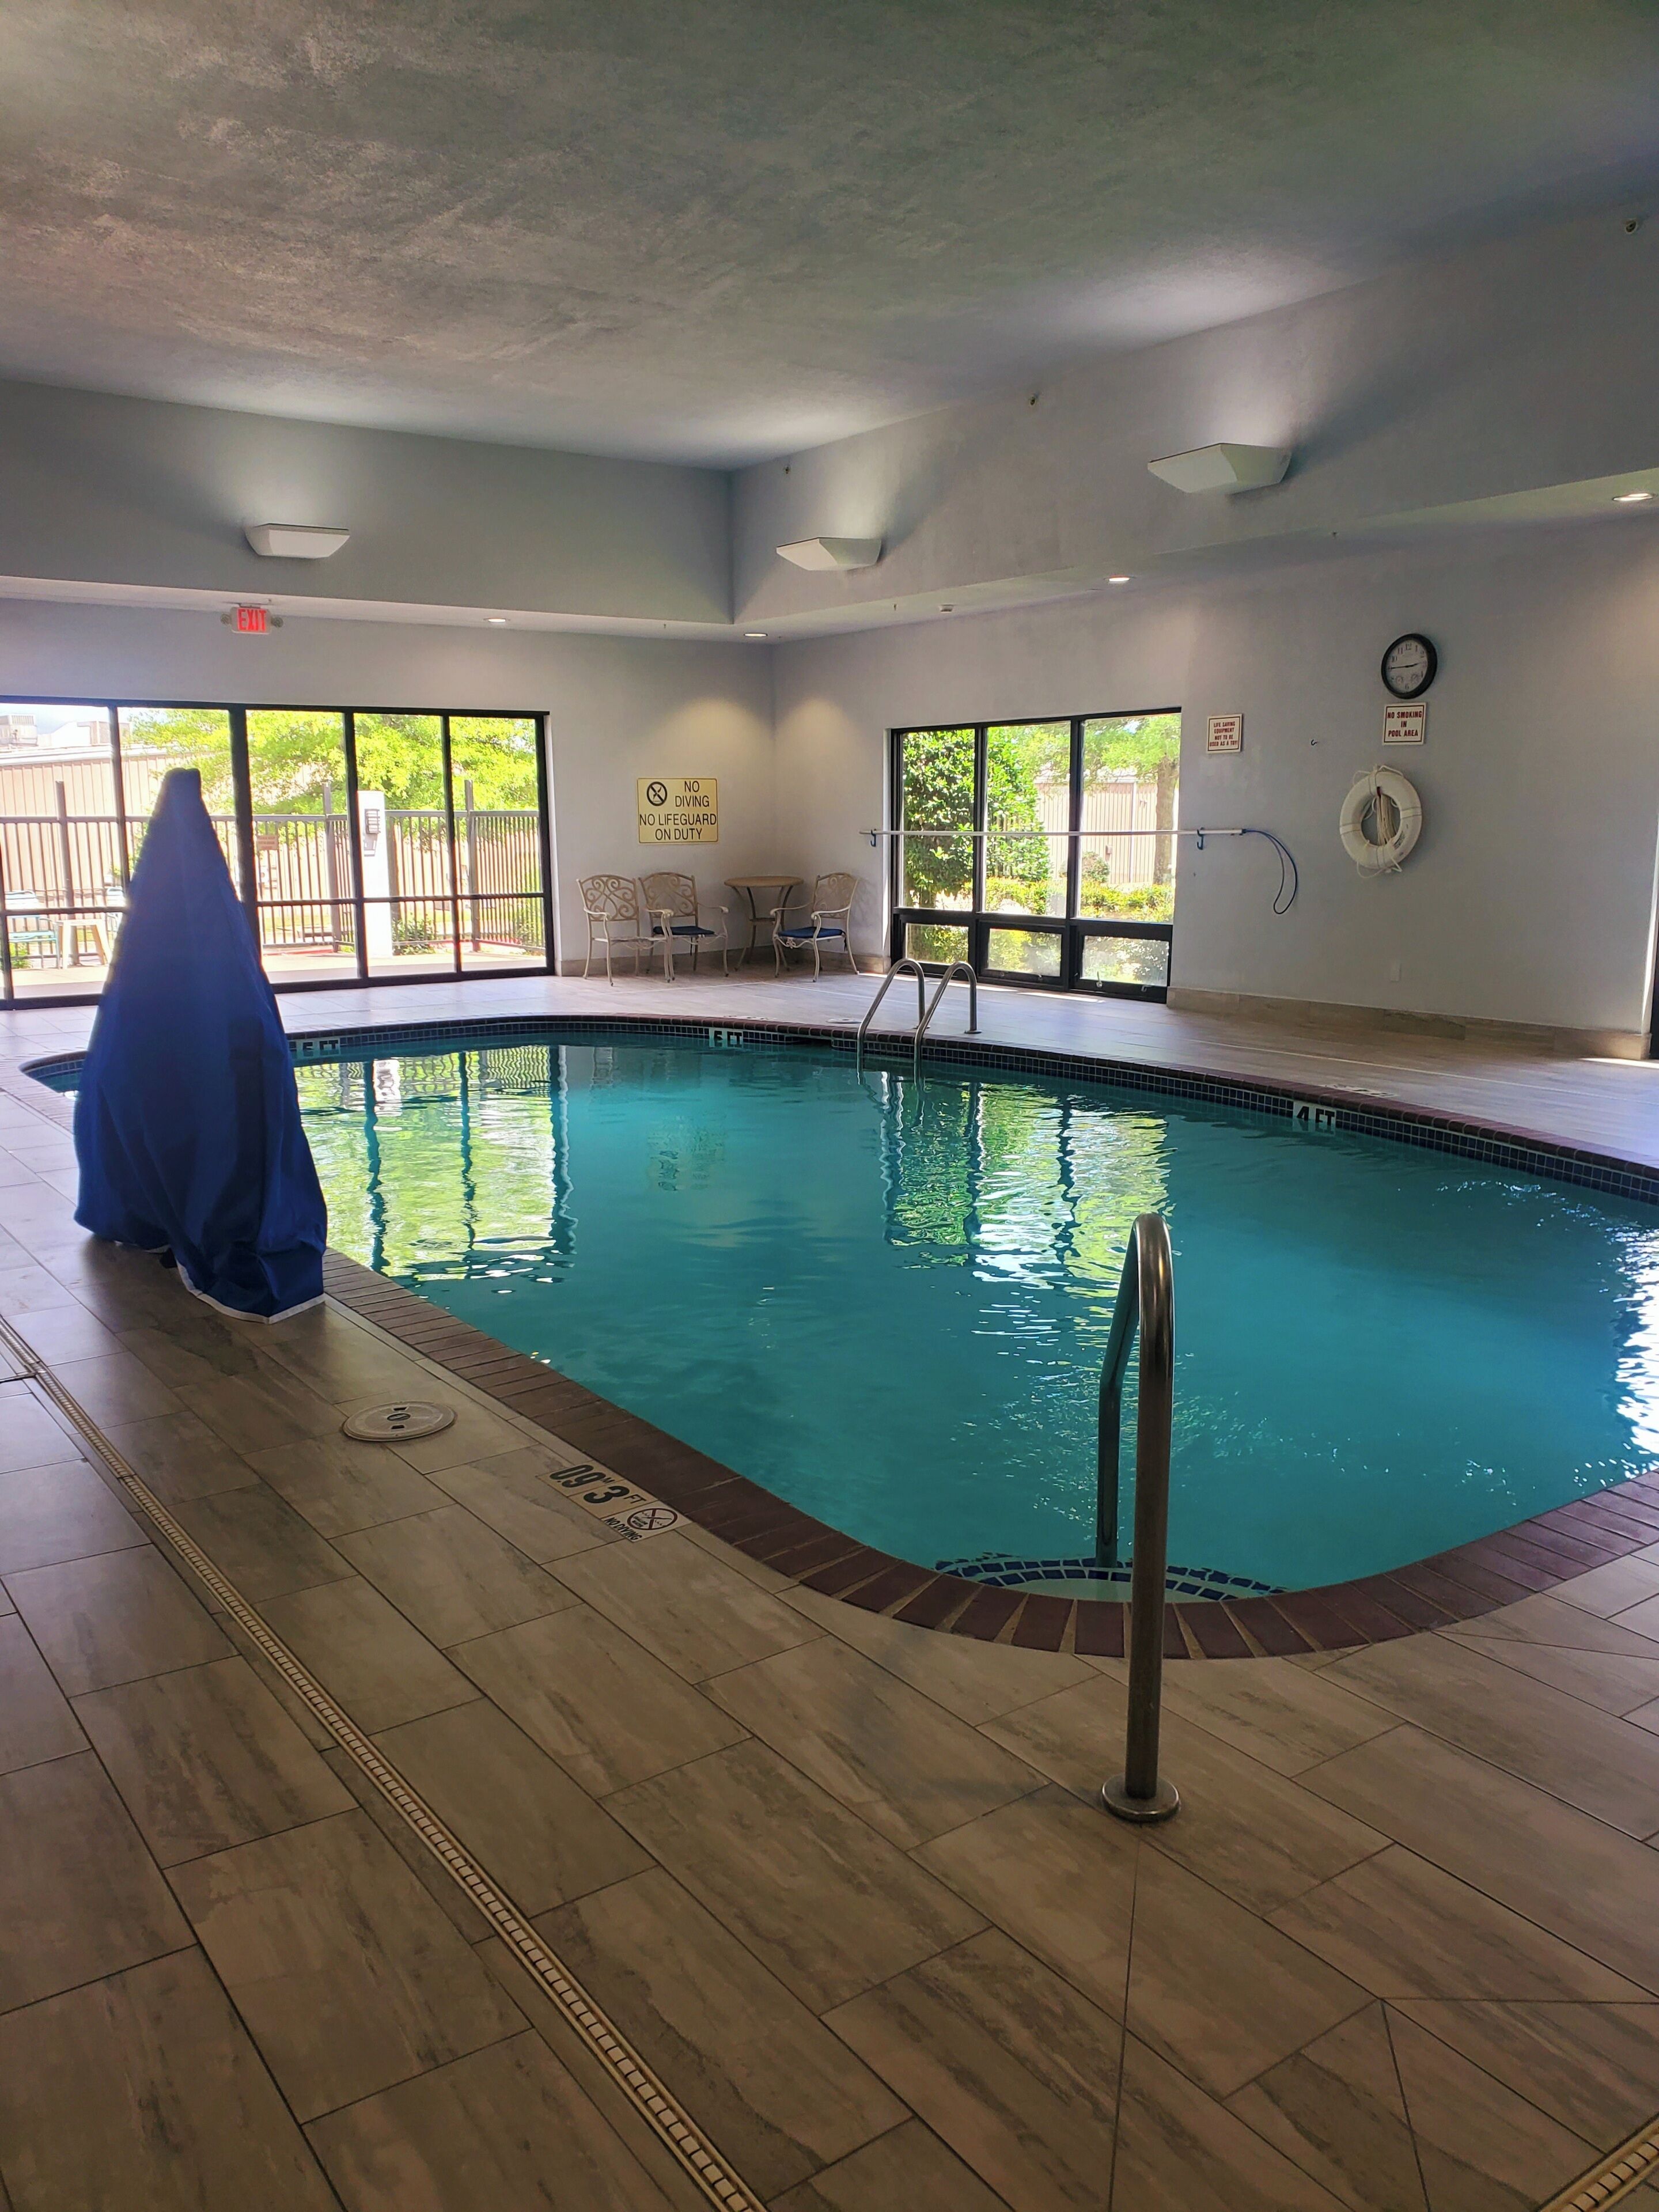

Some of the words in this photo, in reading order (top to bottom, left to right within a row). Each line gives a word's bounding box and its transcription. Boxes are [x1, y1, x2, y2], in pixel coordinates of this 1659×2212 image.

[238, 609, 266, 631] EXIT
[684, 781, 700, 793] NO
[675, 796, 710, 808] DIVING
[639, 813, 656, 826] NO
[658, 813, 717, 825] LIFEGUARD
[655, 828, 671, 840] ON
[675, 828, 703, 840] DUTY
[1296, 1105, 1309, 1121] 4
[1315, 1108, 1335, 1126] FT
[604, 1517, 621, 1525] NO
[613, 1524, 642, 1540] DIVING
